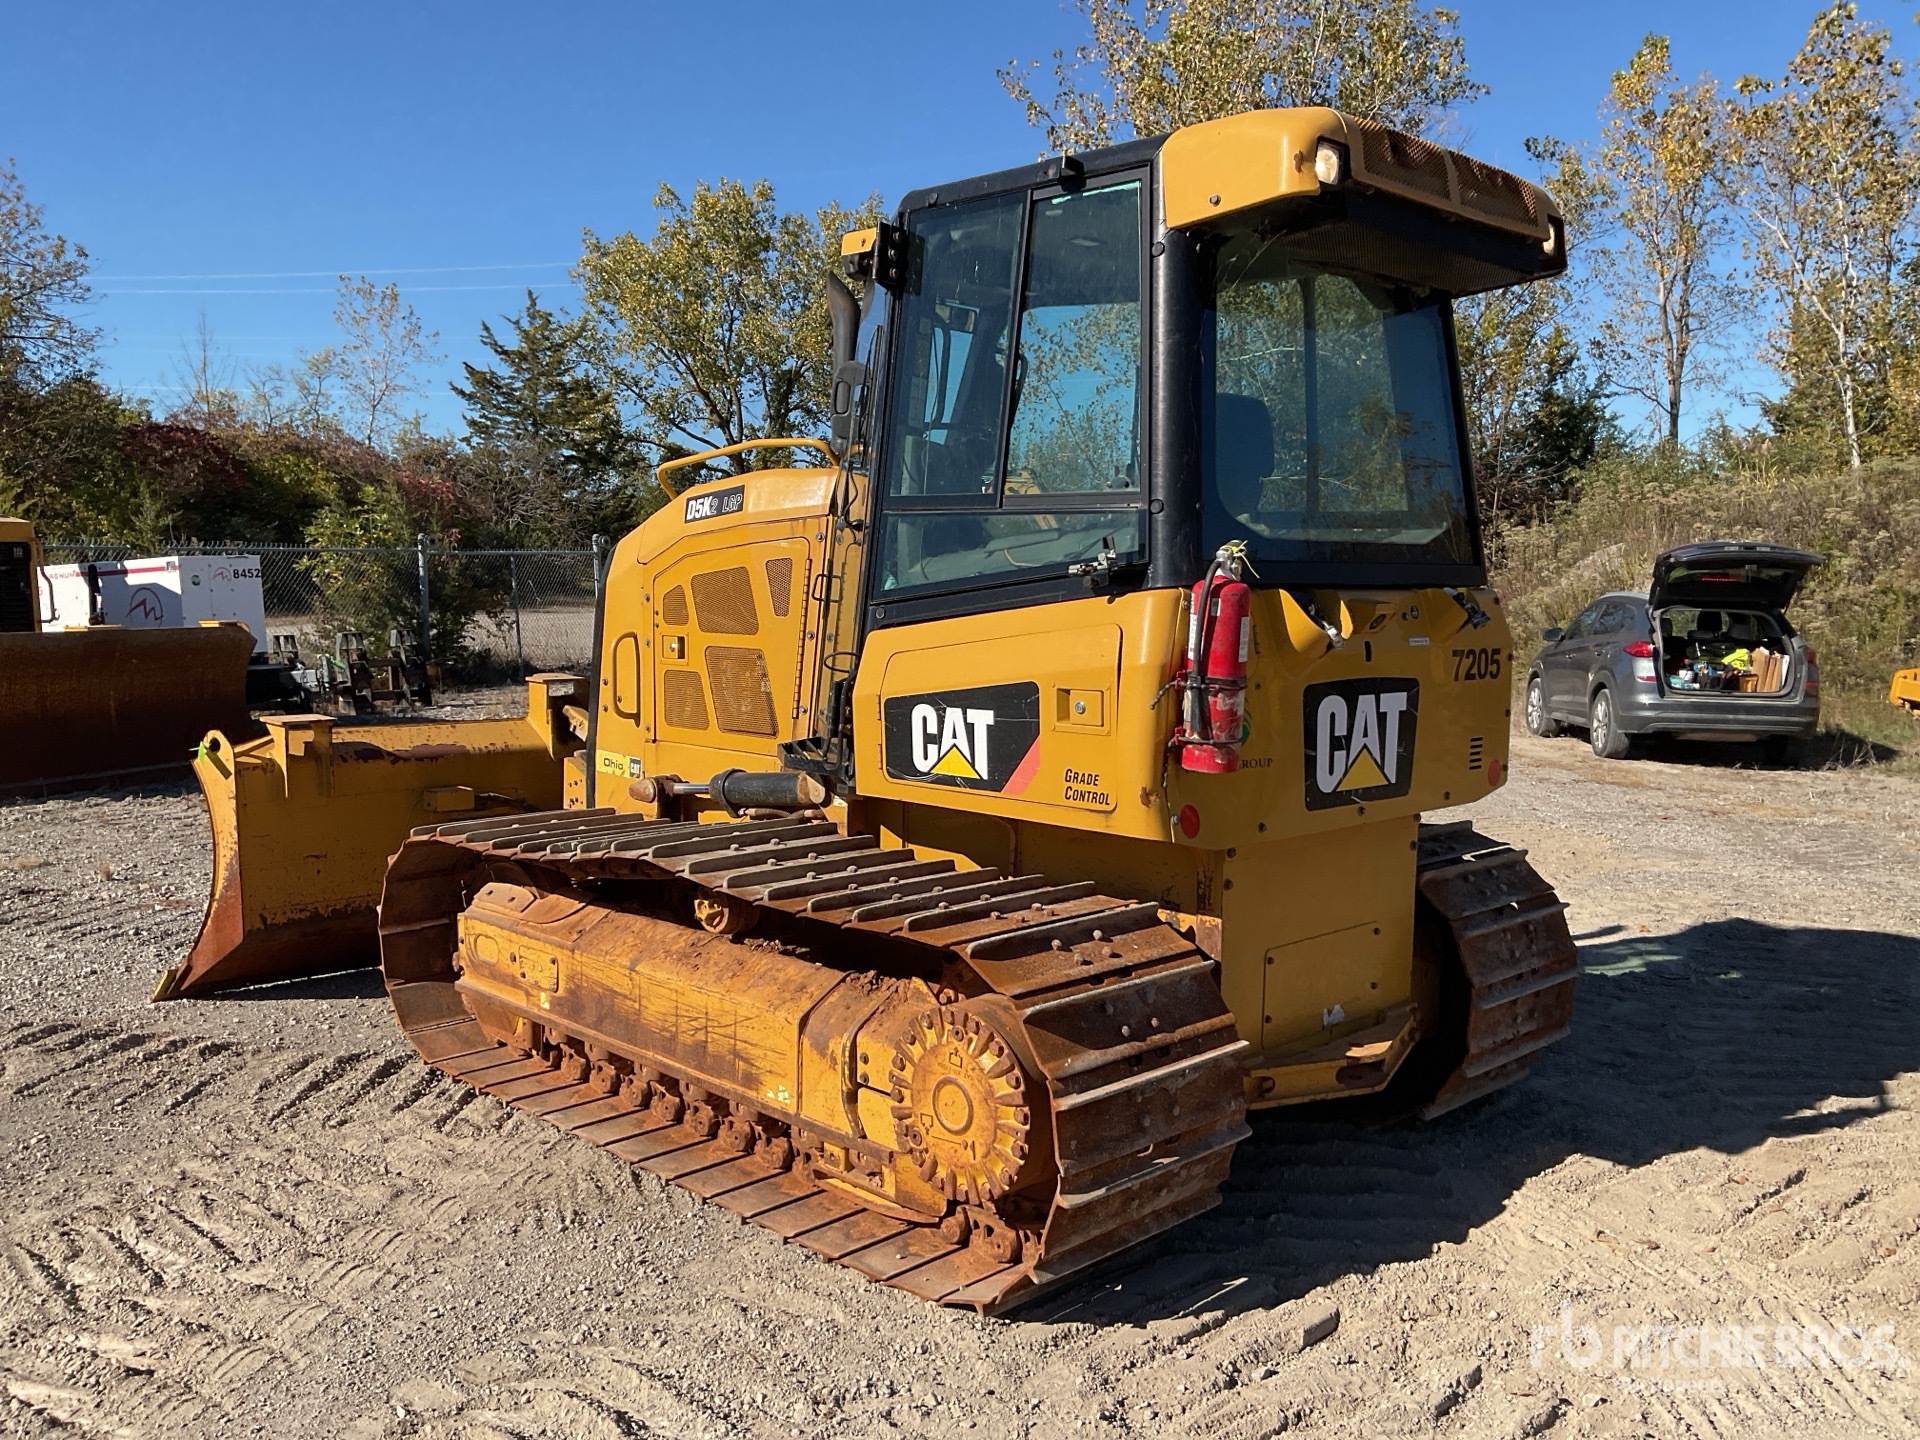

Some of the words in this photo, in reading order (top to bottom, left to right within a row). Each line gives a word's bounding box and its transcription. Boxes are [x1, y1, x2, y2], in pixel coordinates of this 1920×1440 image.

[233, 568, 262, 579] 8452
[1451, 647, 1502, 682] 7205
[911, 702, 995, 780] CAT
[1316, 691, 1408, 794] CAT
[603, 757, 624, 771] Ohio
[1239, 757, 1273, 770] ROUP
[1064, 768, 1100, 787] GRADE
[1064, 785, 1111, 806] CONTROL
